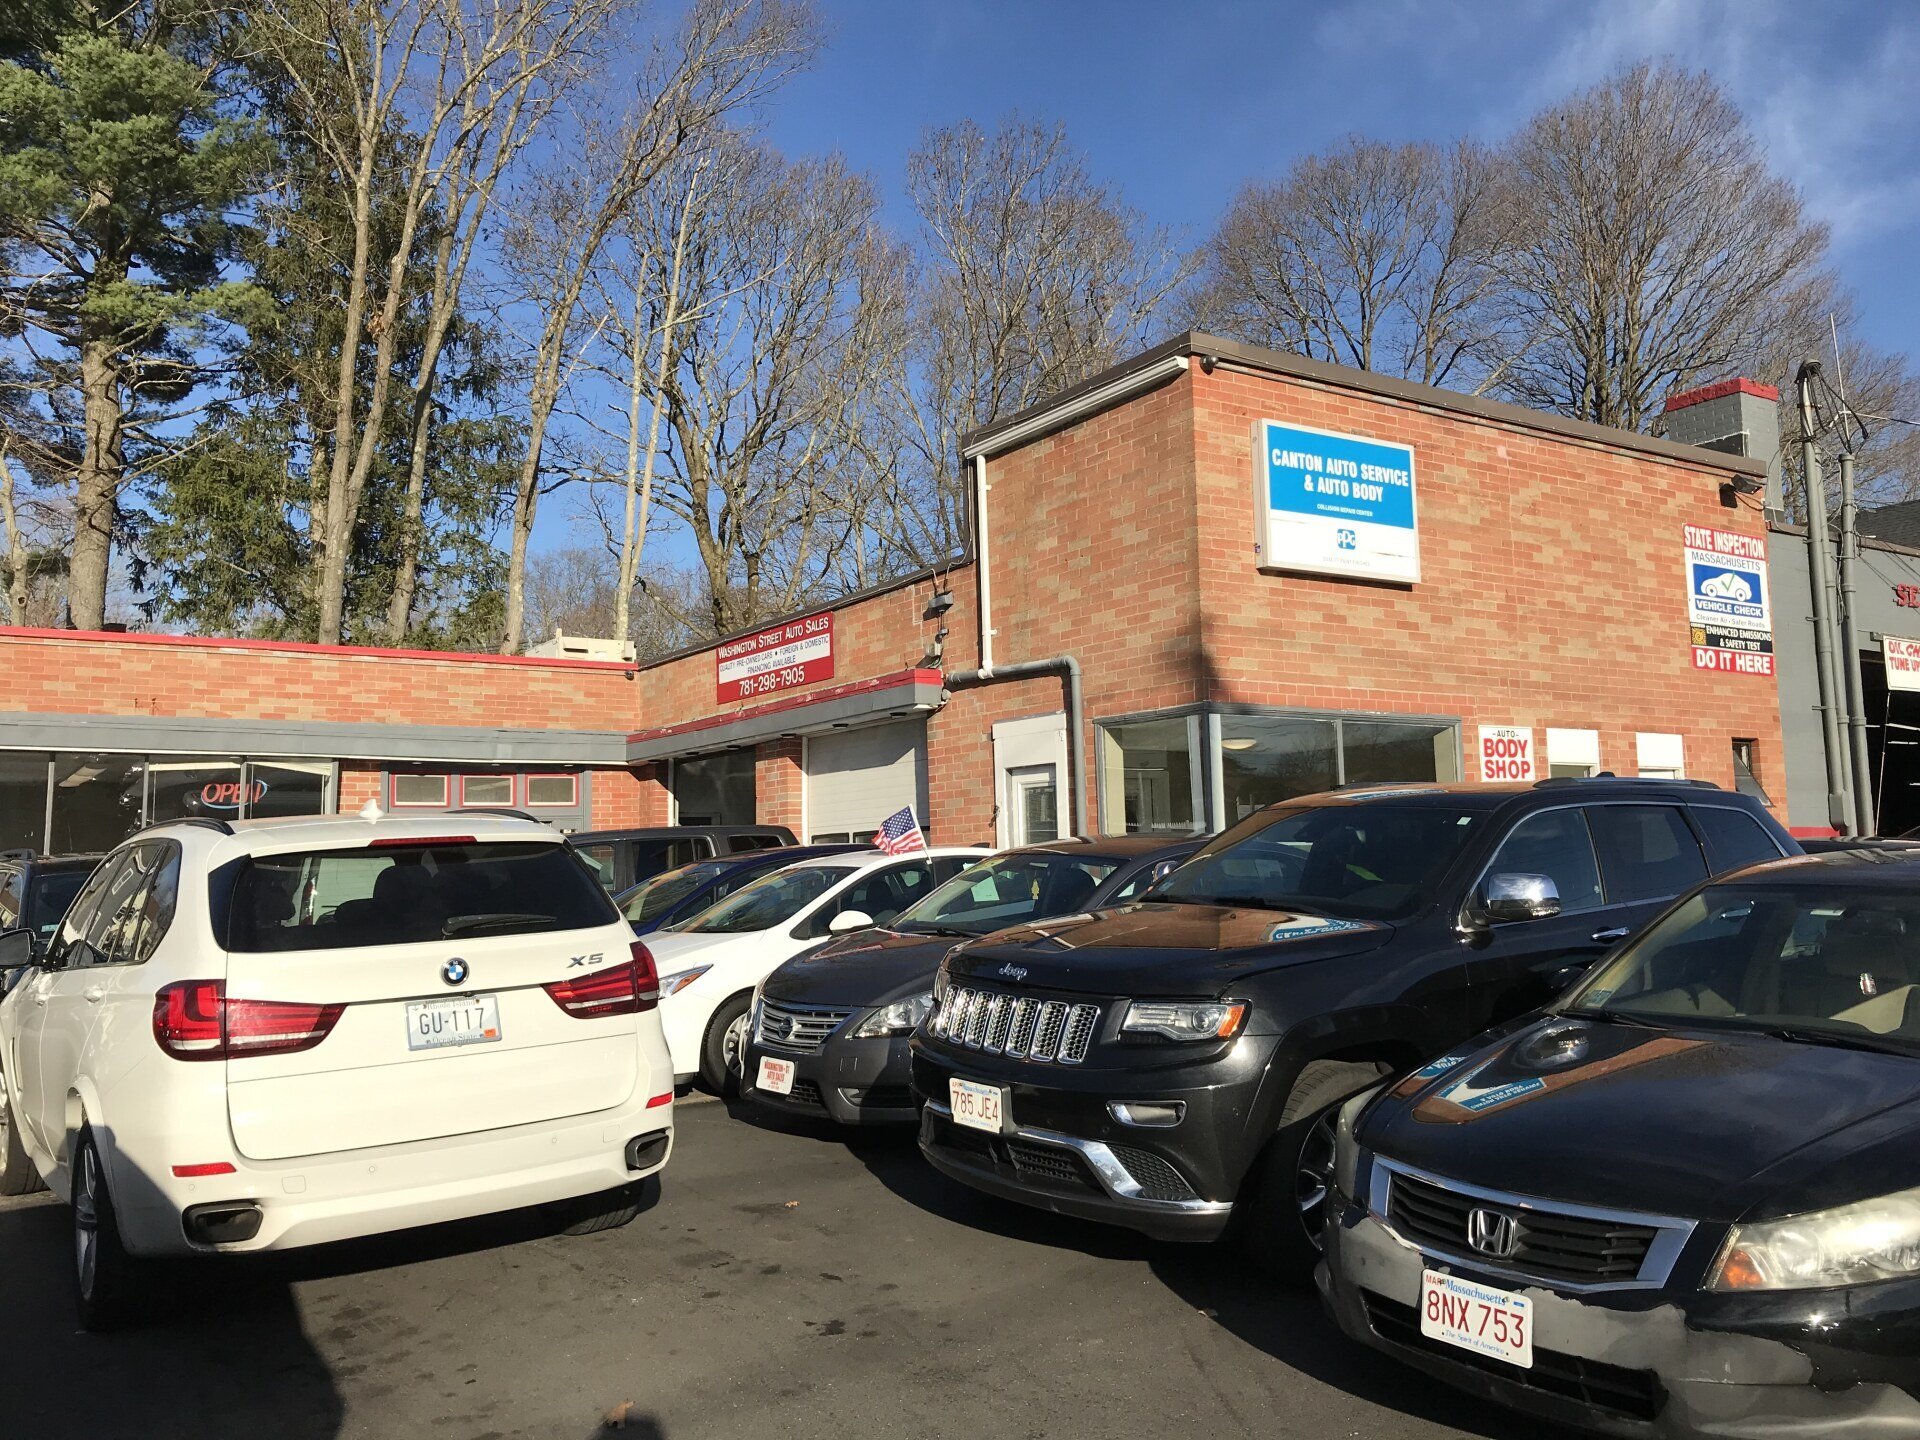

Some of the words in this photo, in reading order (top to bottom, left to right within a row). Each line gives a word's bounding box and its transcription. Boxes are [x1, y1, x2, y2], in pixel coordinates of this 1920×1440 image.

[1272, 448, 1322, 472] CANTON
[1326, 458, 1357, 478] AUTO
[1360, 463, 1409, 487] SERVICE
[1304, 474, 1314, 491] &
[1317, 476, 1349, 497] AUTO
[1352, 482, 1383, 502] BODY
[1317, 503, 1340, 512] COLLISION
[1340, 506, 1356, 514] REPAIR
[1356, 509, 1373, 517] CENTER
[1337, 530, 1356, 548] PPG
[1684, 525, 1712, 550] STATE
[1714, 531, 1765, 559] INSPECTION
[1692, 551, 1761, 571] MASSACHUSETTS
[1696, 600, 1733, 614] VEHICLE
[1734, 604, 1762, 617] CHECK
[1696, 613, 1719, 623] Cleaner
[1747, 620, 1765, 628] Roads
[718, 639, 757, 659] WASHINGTON
[758, 631, 783, 648] STREET
[785, 624, 804, 640] AUTO
[805, 617, 829, 634] SALES
[1706, 625, 1738, 638] ENHANCED
[1739, 629, 1772, 642] EMISSIONS
[720, 662, 736, 672] QUALITY
[736, 655, 761, 668] PRE-OWNED
[761, 651, 773, 660] CARS
[779, 644, 799, 656] FOREIGN
[804, 636, 829, 649] DOMESTIC
[1720, 638, 1724, 646] &
[1725, 639, 1746, 650] SAFETY
[1746, 641, 1761, 650] TEST
[1888, 640, 1904, 655] OIL
[747, 660, 772, 675] FINANCING
[772, 655, 796, 668] AVAILABLE
[1696, 649, 1716, 668] DO
[1719, 652, 1733, 671] IT
[1736, 654, 1771, 675] HERE
[1889, 656, 1910, 671] TUNE
[739, 666, 805, 697] 781-298-7905
[1483, 738, 1528, 758] BODY
[1485, 759, 1530, 779] SHOP
[566, 953, 604, 968] X5
[998, 962, 1028, 981] Jeep
[420, 1008, 484, 1035] GU-117
[952, 1091, 974, 1115] 785
[978, 1096, 998, 1122] JE4
[1446, 1279, 1506, 1306] Massachusetts
[1427, 1290, 1470, 1332] 8NX
[1478, 1304, 1524, 1348] 753
